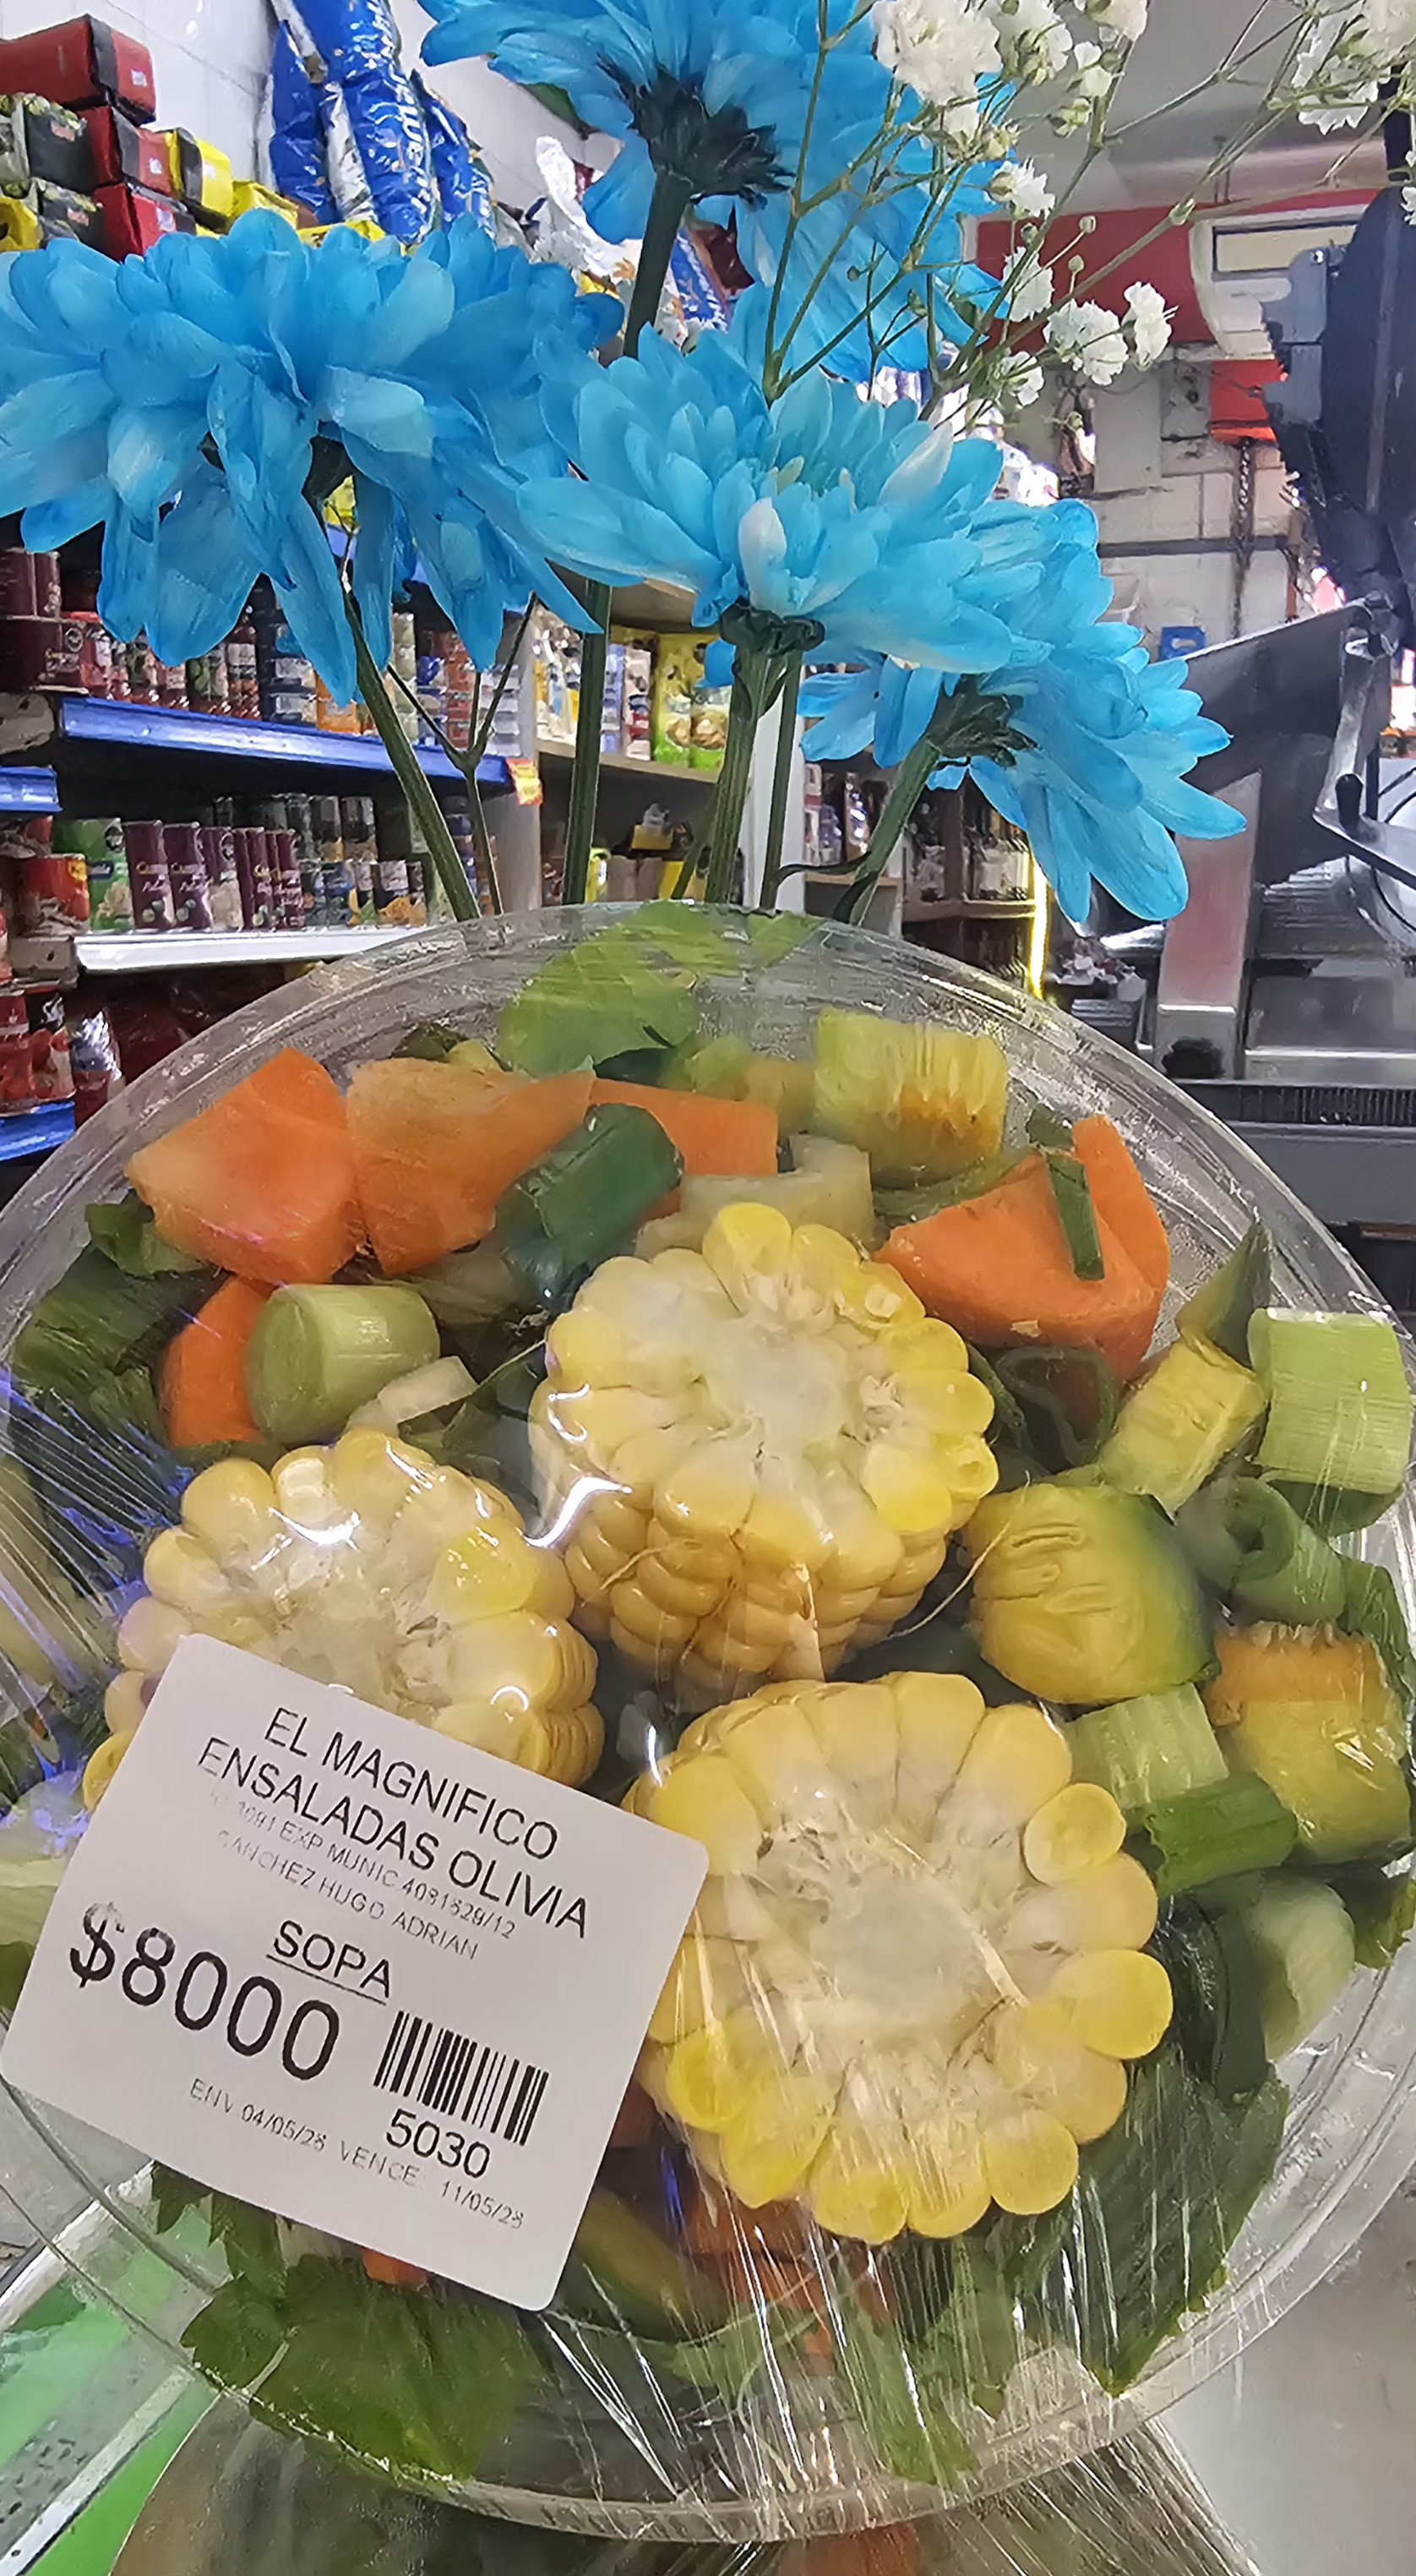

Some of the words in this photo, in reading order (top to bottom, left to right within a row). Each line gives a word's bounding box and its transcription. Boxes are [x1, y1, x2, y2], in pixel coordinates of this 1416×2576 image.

[264, 1707, 308, 1757] EL
[322, 1732, 558, 1860] MAGNIFICO
[198, 1737, 439, 1870] ENSALADAS
[449, 1850, 586, 1939] OLIVIA
[280, 1820, 324, 1851] EXP
[326, 1843, 399, 1888] MUNIC
[273, 1919, 390, 1999] SOPA
[319, 1876, 384, 1920] HUGO
[392, 1911, 478, 1960] ADRIAN
[69, 1901, 340, 2081] $8000
[190, 2077, 234, 2114] ENV
[386, 2108, 491, 2178] 5030
